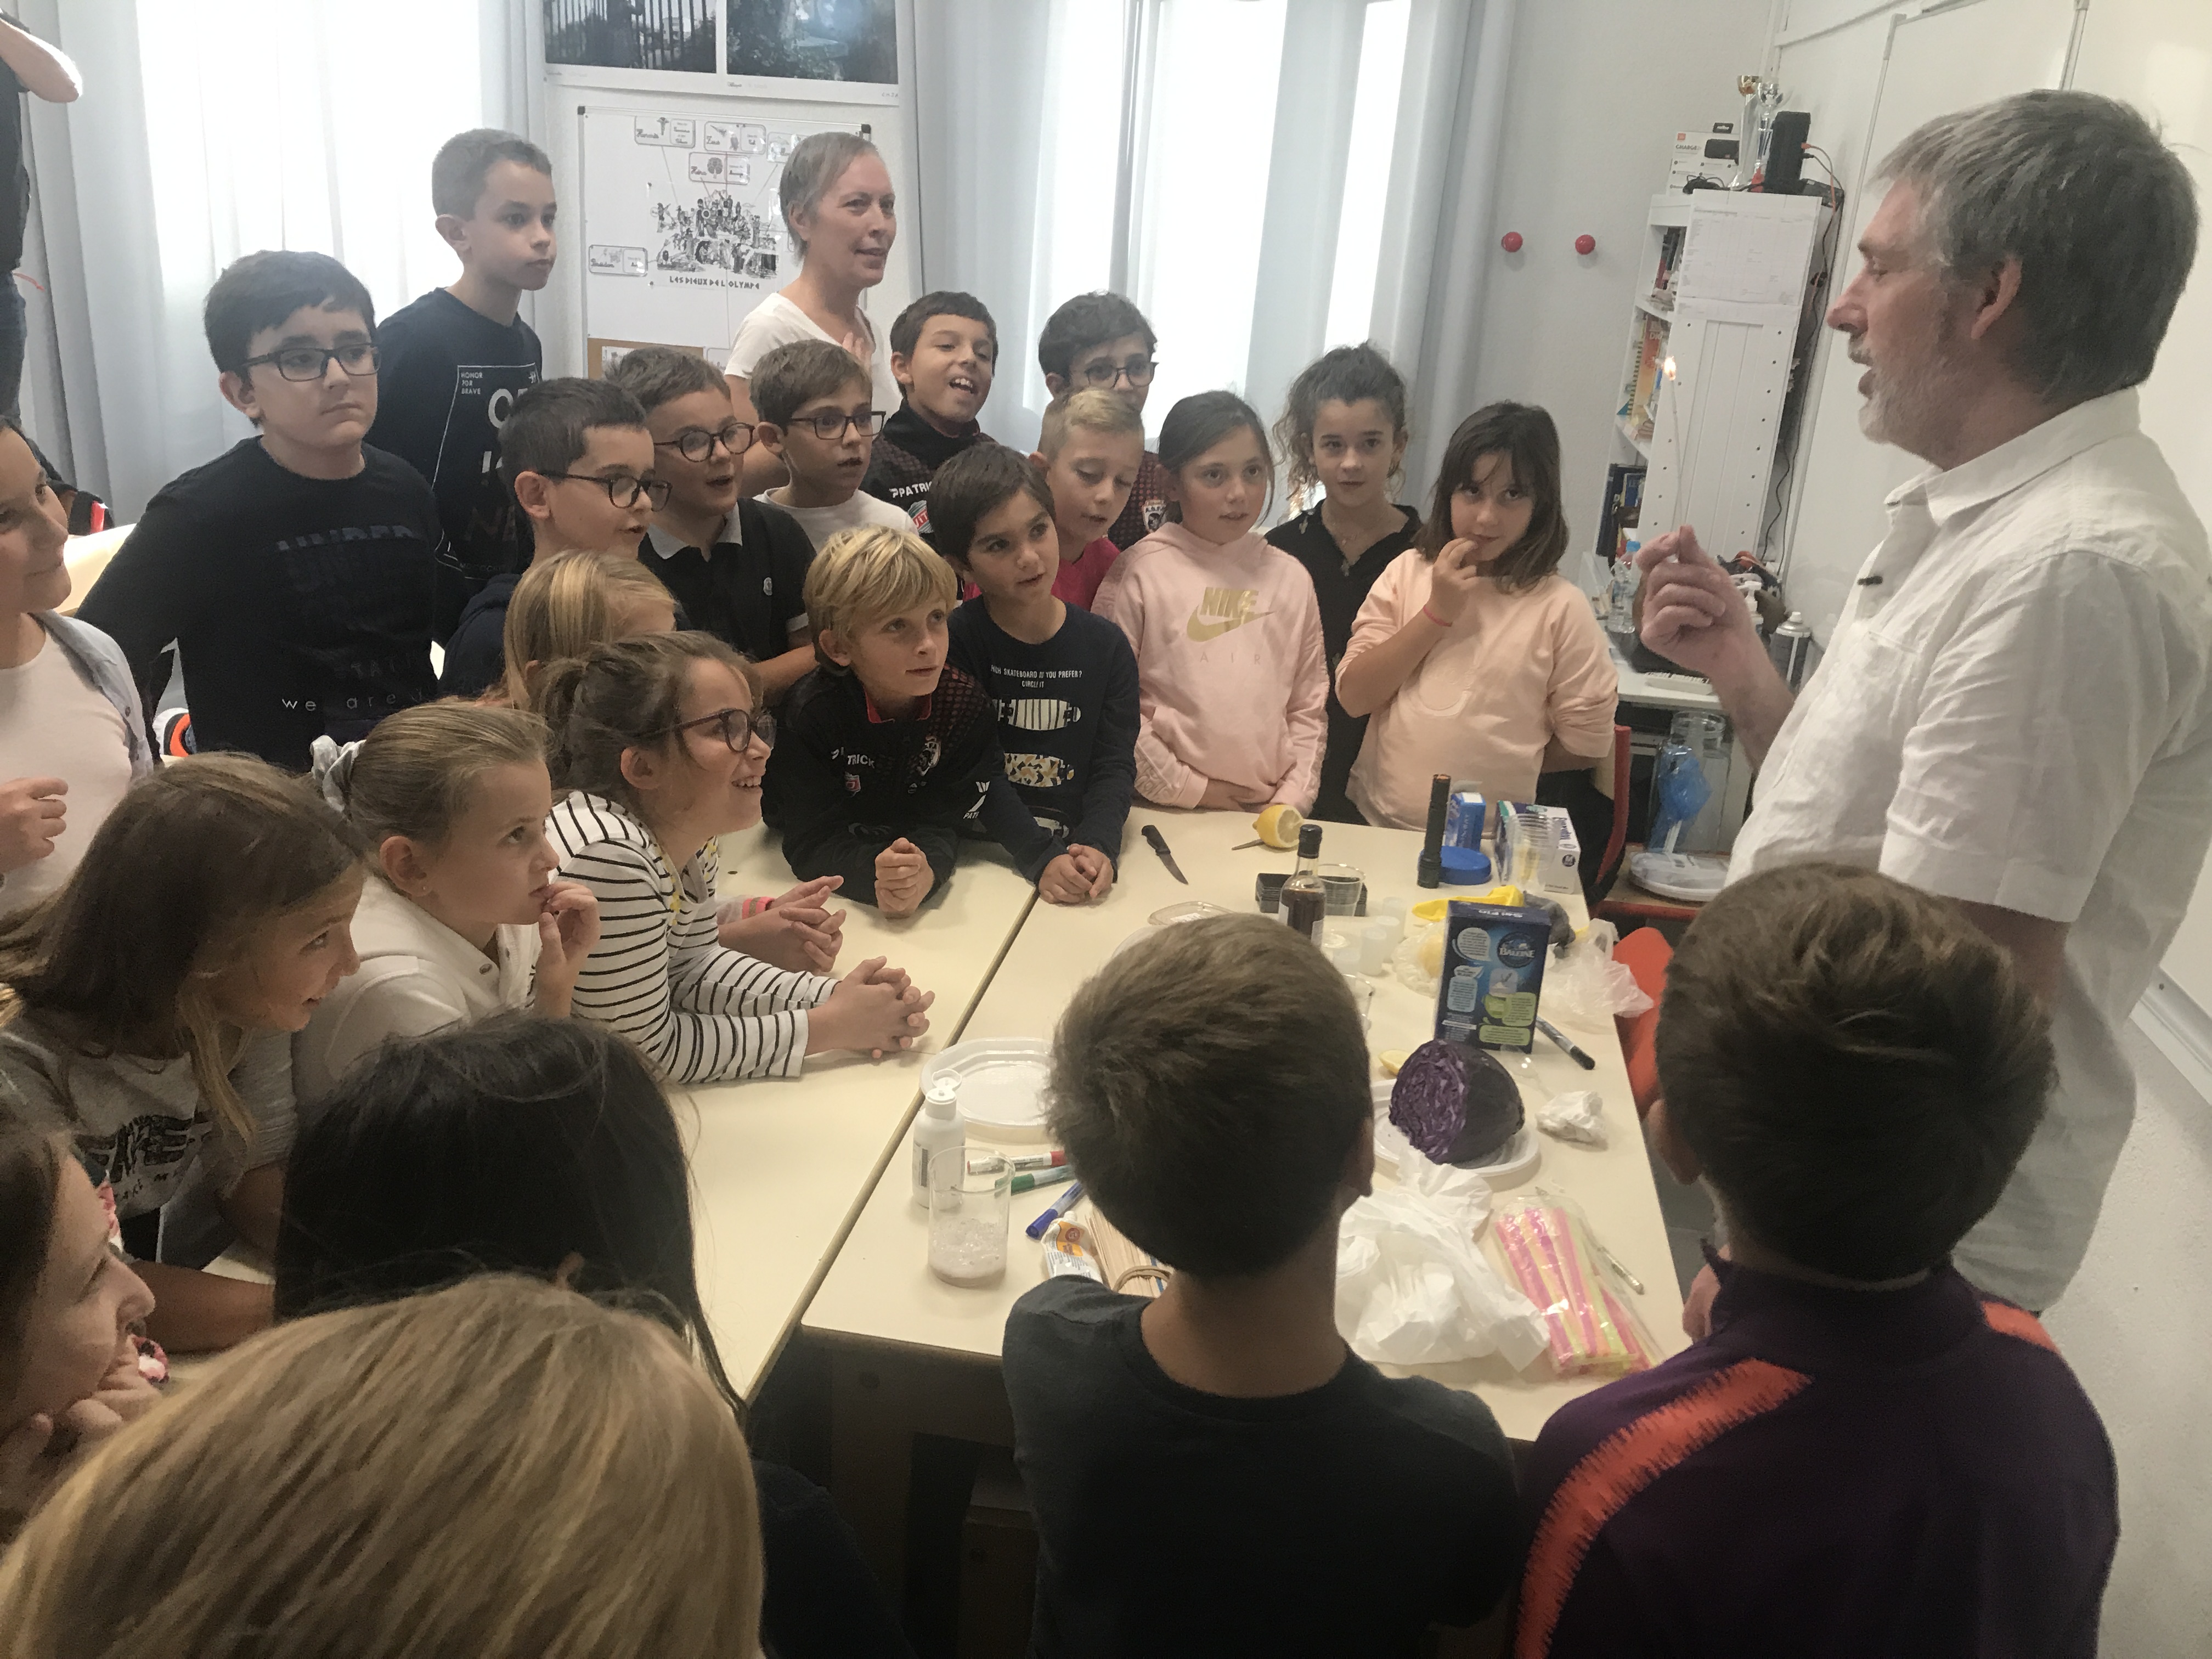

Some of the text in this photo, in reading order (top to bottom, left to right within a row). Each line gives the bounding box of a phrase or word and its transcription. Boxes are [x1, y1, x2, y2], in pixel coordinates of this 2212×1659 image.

[685, 276, 708, 285] DIEUX
[1200, 586, 1260, 619] NIKE
[1200, 651, 1261, 665] AIR
[1003, 668, 1037, 678] SKATEBOARD
[1045, 670, 1057, 679] YOU
[281, 698, 317, 712] we
[346, 693, 397, 709] are
